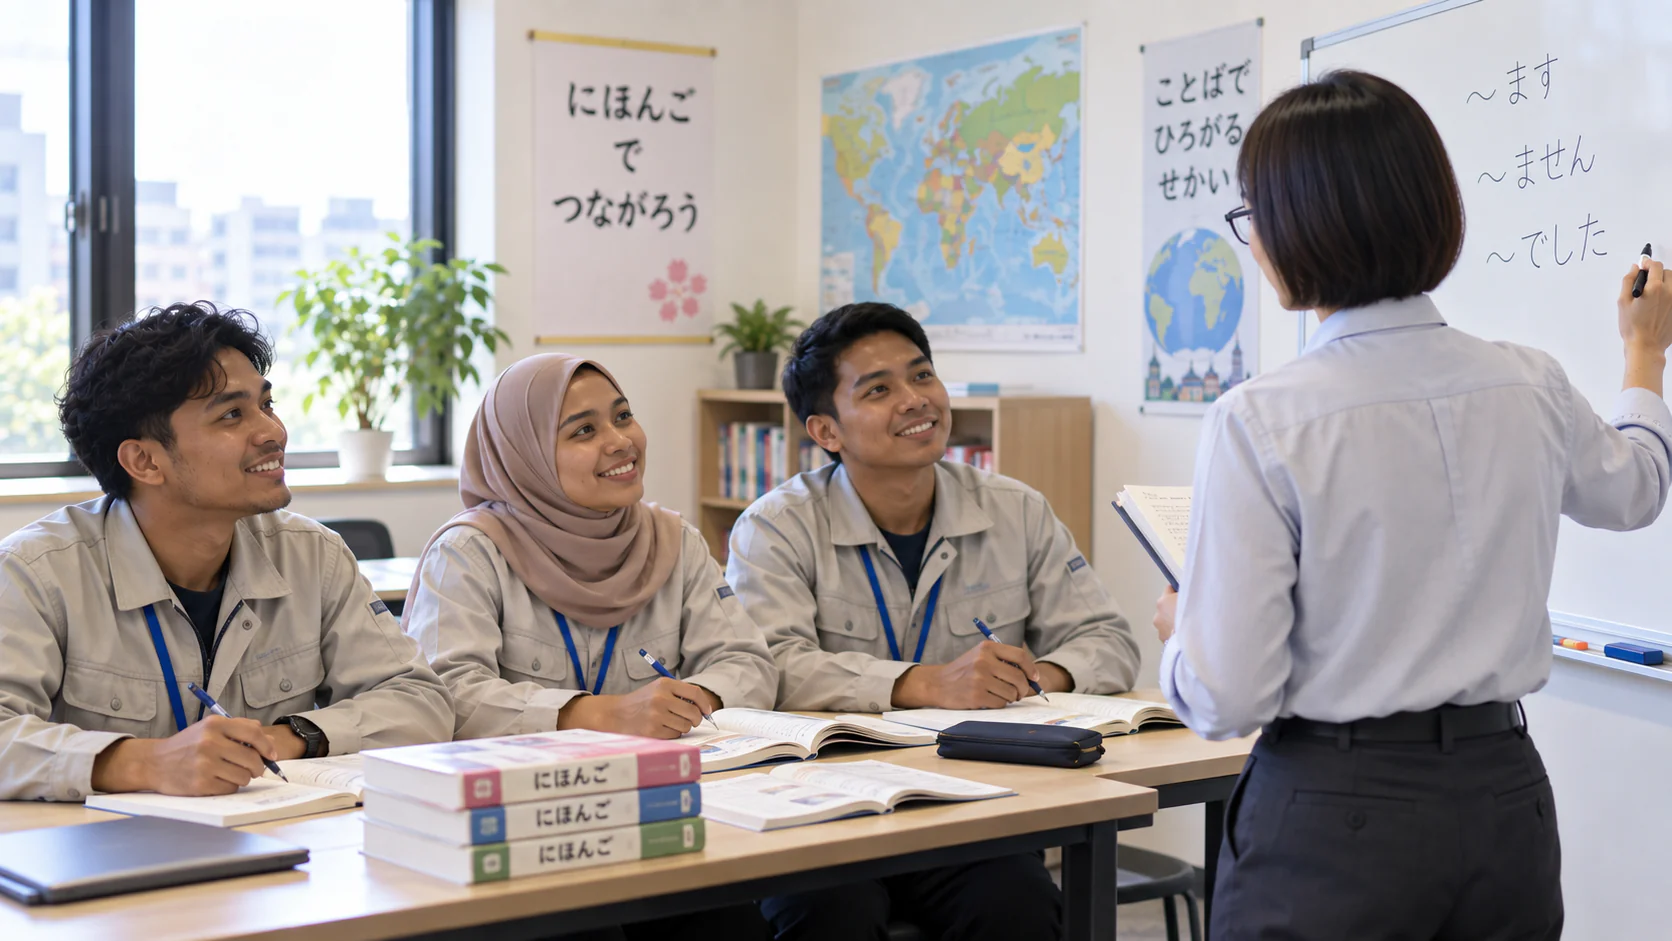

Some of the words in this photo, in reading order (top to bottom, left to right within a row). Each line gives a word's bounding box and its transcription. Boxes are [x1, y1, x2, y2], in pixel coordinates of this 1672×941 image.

[1156, 59, 1252, 107] ことばで
[568, 81, 696, 123] にほんご
[1154, 112, 1243, 154] ひろがる
[614, 138, 643, 173] で
[1158, 166, 1230, 201] せかい
[553, 189, 697, 232] つながろう
[534, 763, 610, 791] にほんご
[536, 800, 611, 828] にほんご
[538, 836, 613, 865] にほんご
